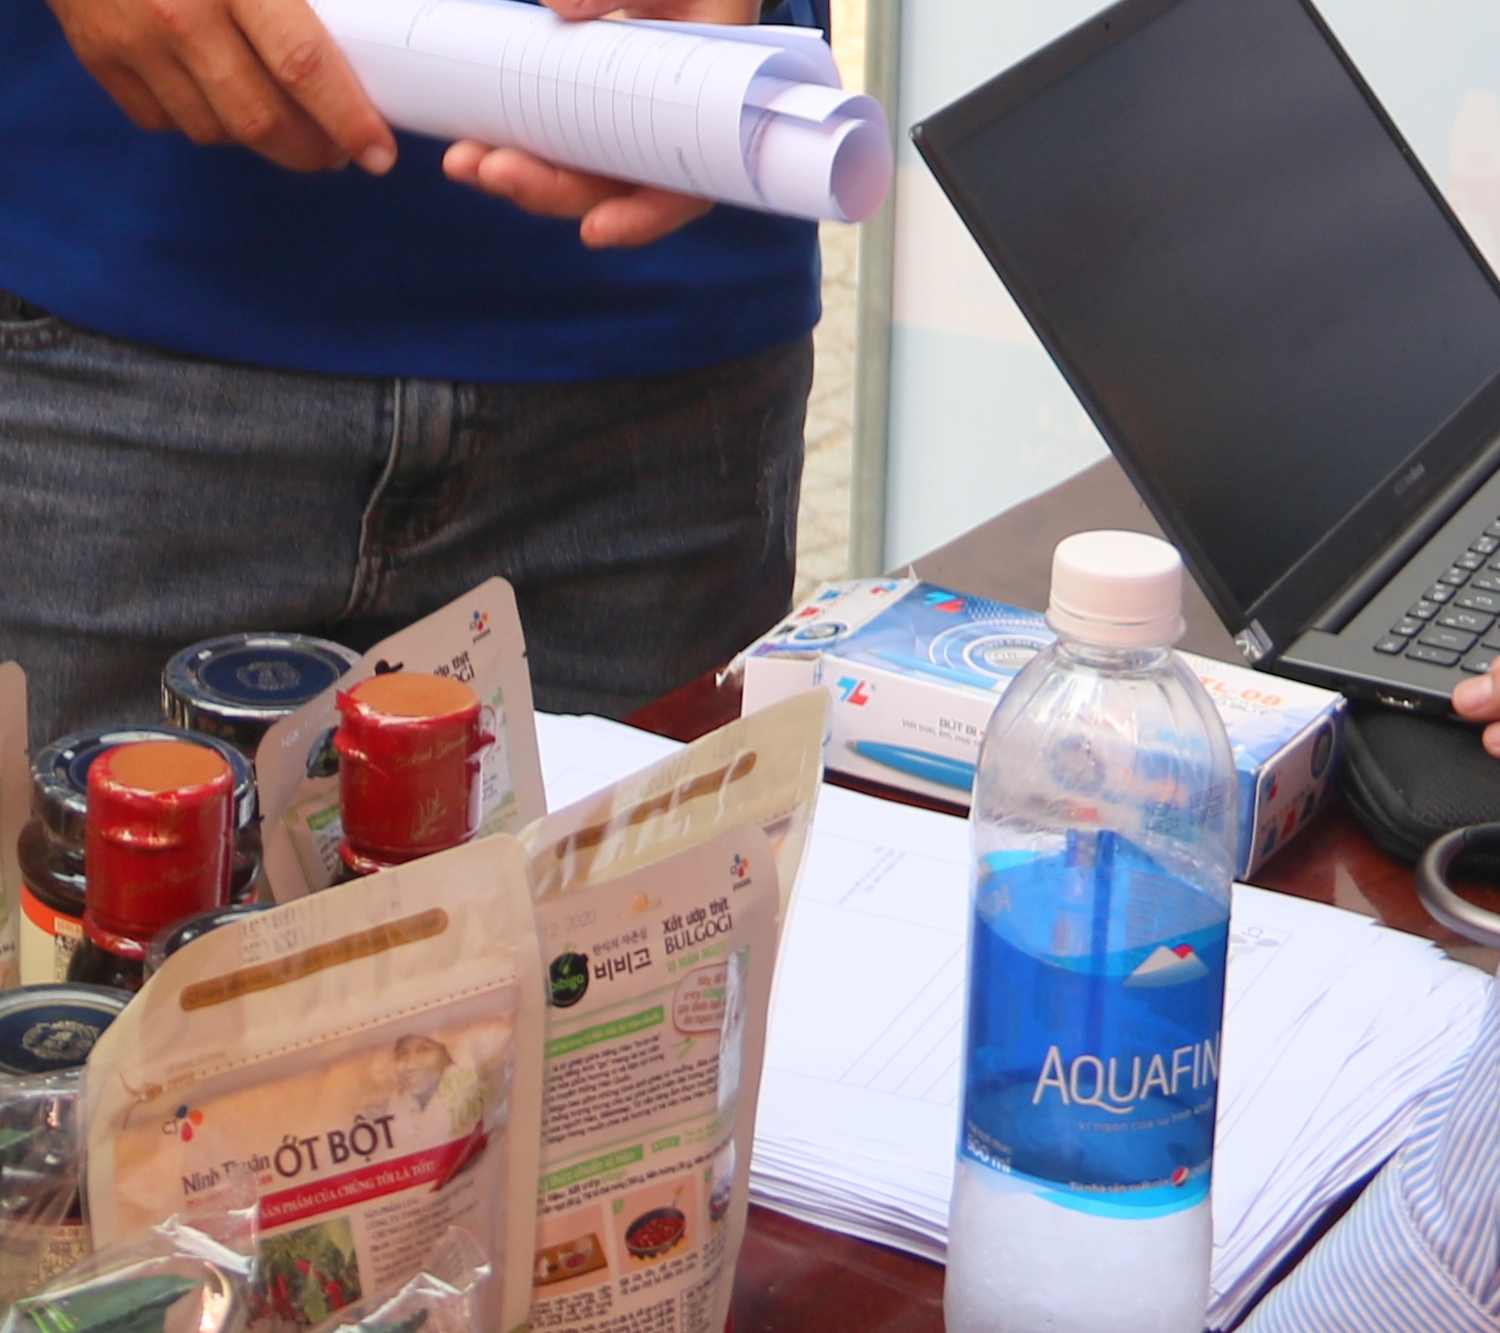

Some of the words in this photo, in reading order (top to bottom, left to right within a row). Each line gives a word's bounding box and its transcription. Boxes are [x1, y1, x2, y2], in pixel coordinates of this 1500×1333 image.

[939, 716, 963, 732] BÚT
[662, 914, 682, 934] Xốt
[709, 897, 729, 916] thịt
[664, 913, 732, 955] BULGOGI
[594, 947, 653, 981] 비비고
[1032, 1031, 1221, 1114] AQUAFIN
[274, 1135, 319, 1178] ỚT
[326, 1114, 396, 1164] BỘT
[181, 1168, 219, 1195] Ninh
[314, 1186, 337, 1204] CỦA
